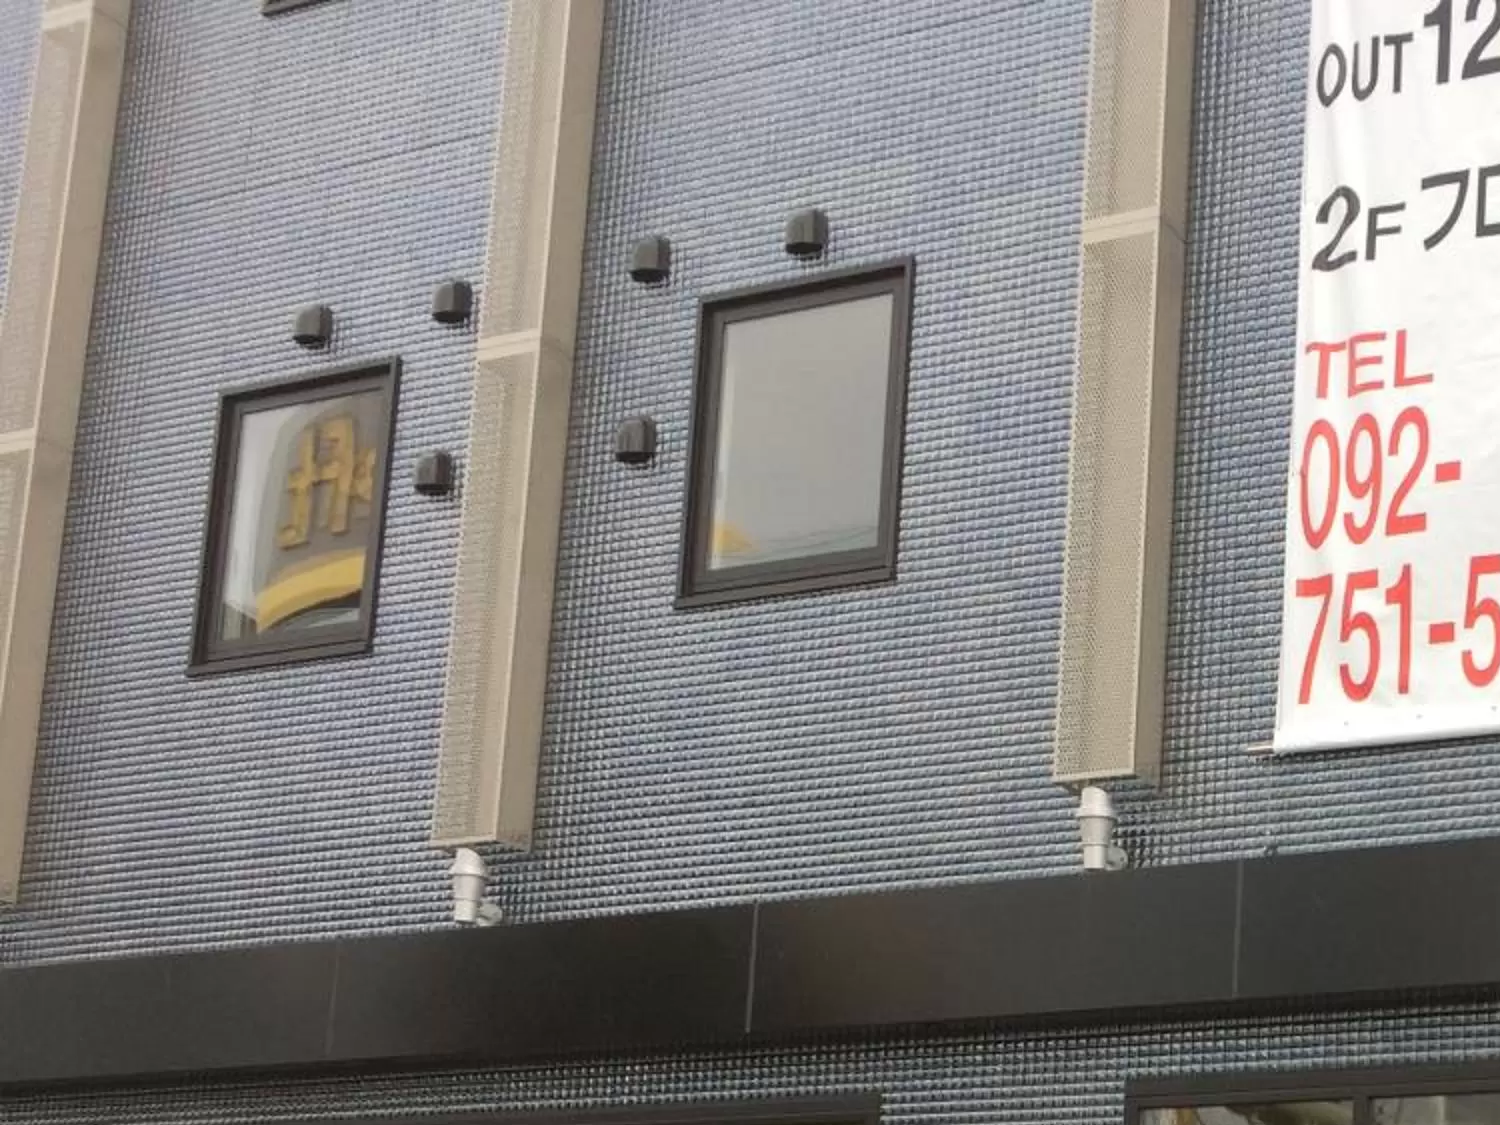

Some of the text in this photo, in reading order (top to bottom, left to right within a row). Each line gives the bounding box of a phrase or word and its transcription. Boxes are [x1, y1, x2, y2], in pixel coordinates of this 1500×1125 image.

[1316, 32, 1414, 107] OUT
[1305, 328, 1434, 398] TEL
[1299, 406, 1461, 551] 092-
